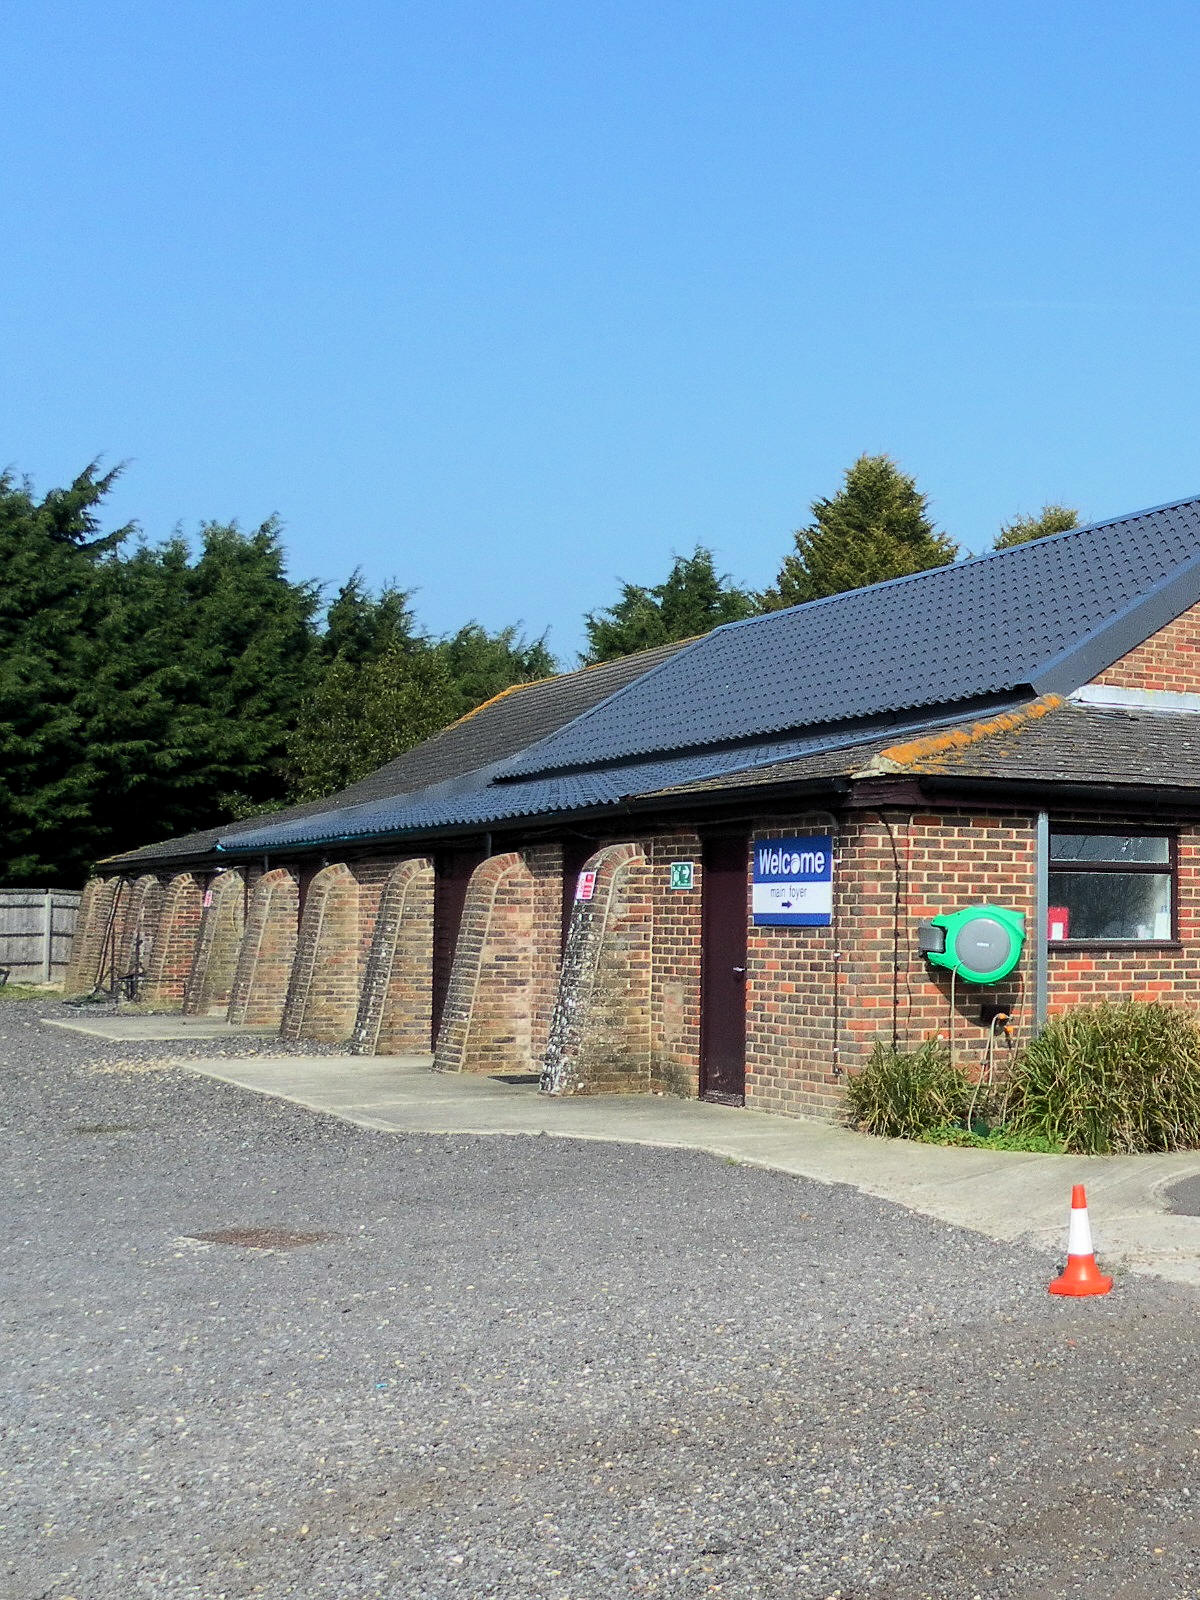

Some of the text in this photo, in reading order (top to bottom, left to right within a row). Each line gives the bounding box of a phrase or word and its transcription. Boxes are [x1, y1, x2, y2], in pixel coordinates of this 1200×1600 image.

[759, 847, 826, 875] Welcome
[770, 885, 808, 900] main foyer
